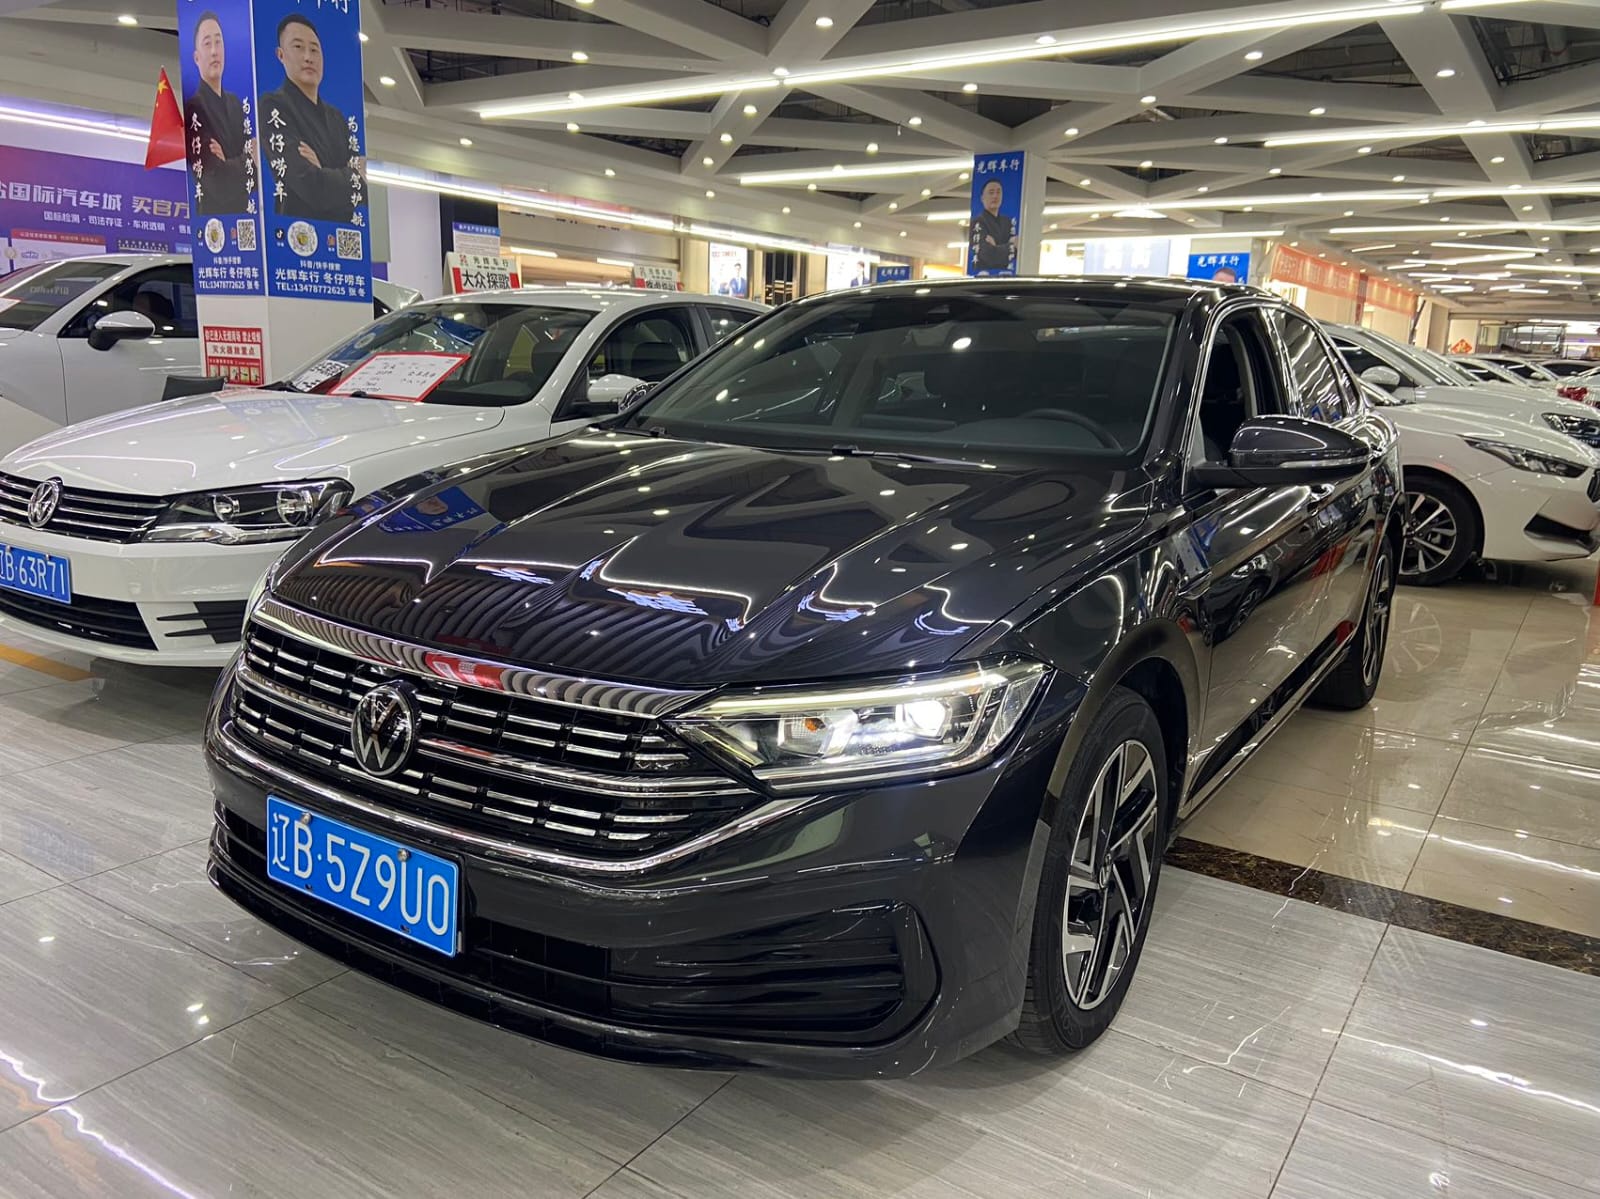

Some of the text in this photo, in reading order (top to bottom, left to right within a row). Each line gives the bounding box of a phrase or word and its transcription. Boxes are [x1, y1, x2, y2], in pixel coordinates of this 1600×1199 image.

[190, 113, 204, 203] 冬仔唠车
[267, 108, 288, 203] 冬仔唠车
[347, 115, 366, 227] 为您保驾护航
[198, 267, 227, 279] 光辉车行
[275, 268, 366, 287] 光辉车行 冬仔唠车
[462, 269, 511, 290] 大众探歌
[276, 282, 346, 296] TEL:13478772625
